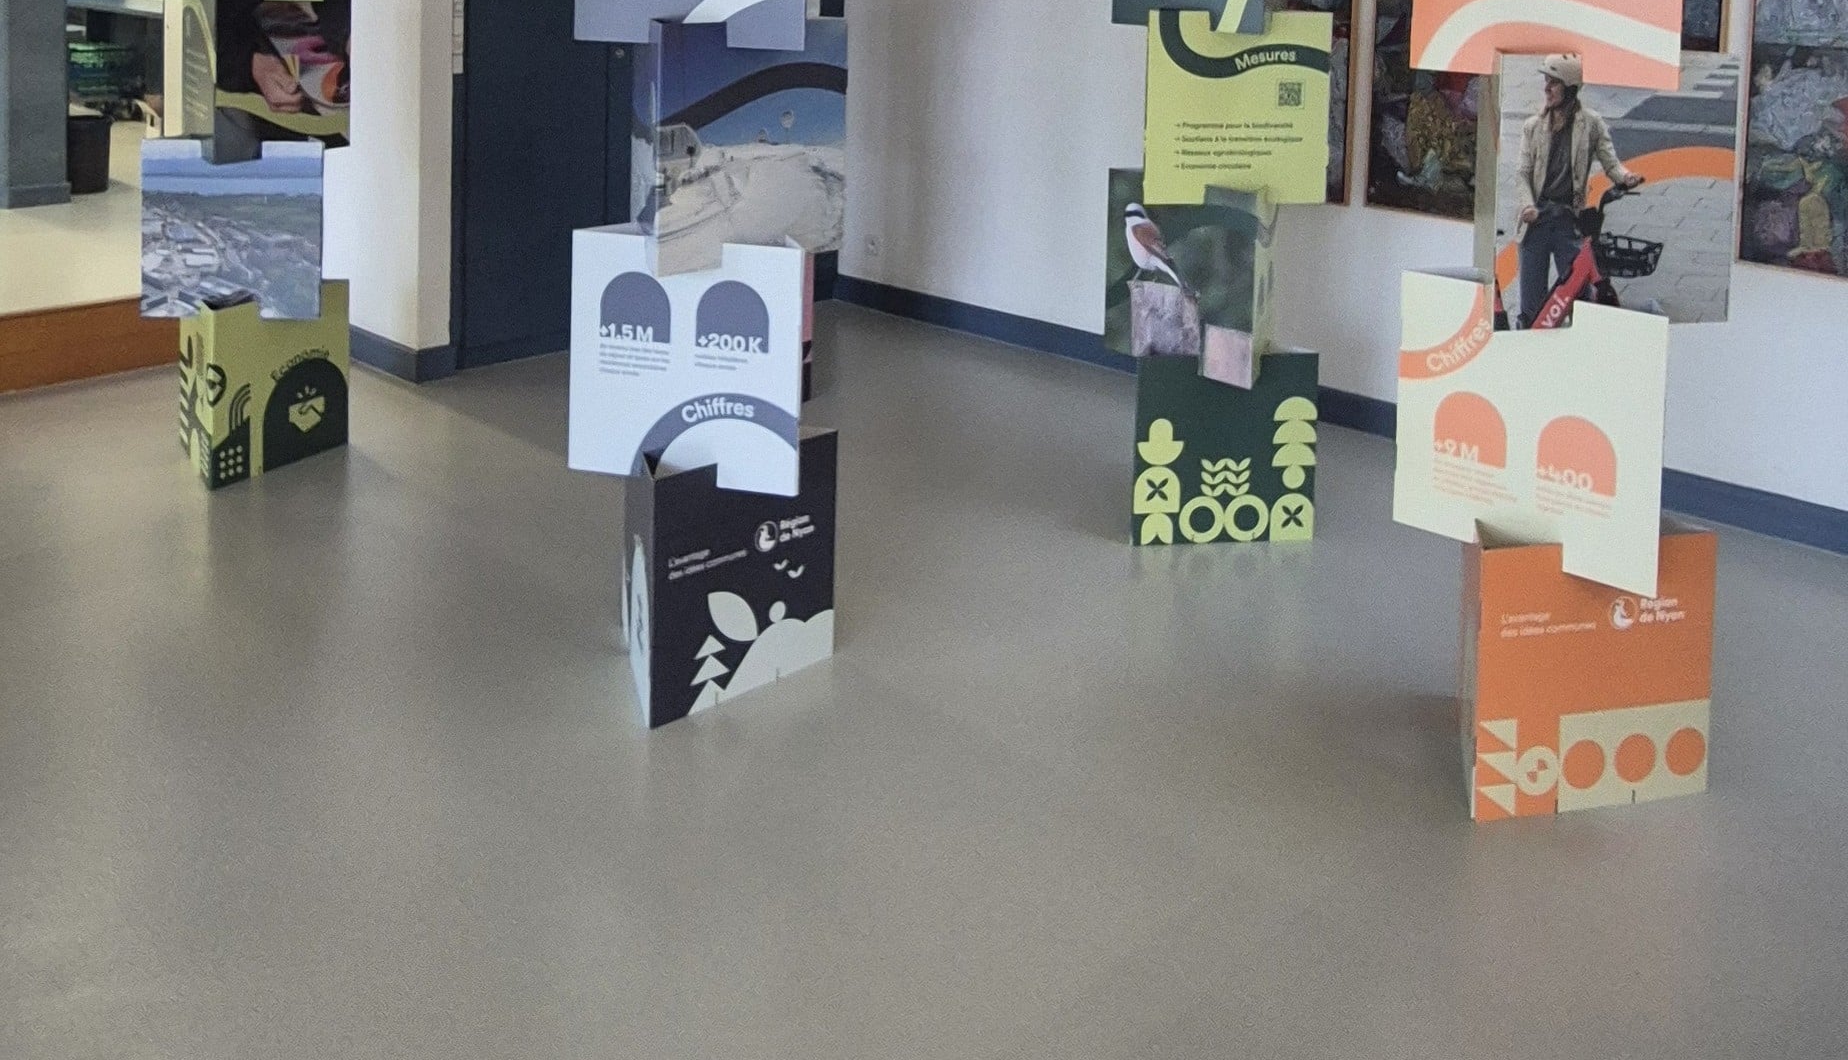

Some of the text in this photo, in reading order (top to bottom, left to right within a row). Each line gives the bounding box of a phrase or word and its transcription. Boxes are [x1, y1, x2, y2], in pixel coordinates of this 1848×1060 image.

[1235, 50, 1296, 71] Mesures
[1426, 318, 1491, 371] Chiffres
[682, 397, 754, 422] Chiffres
